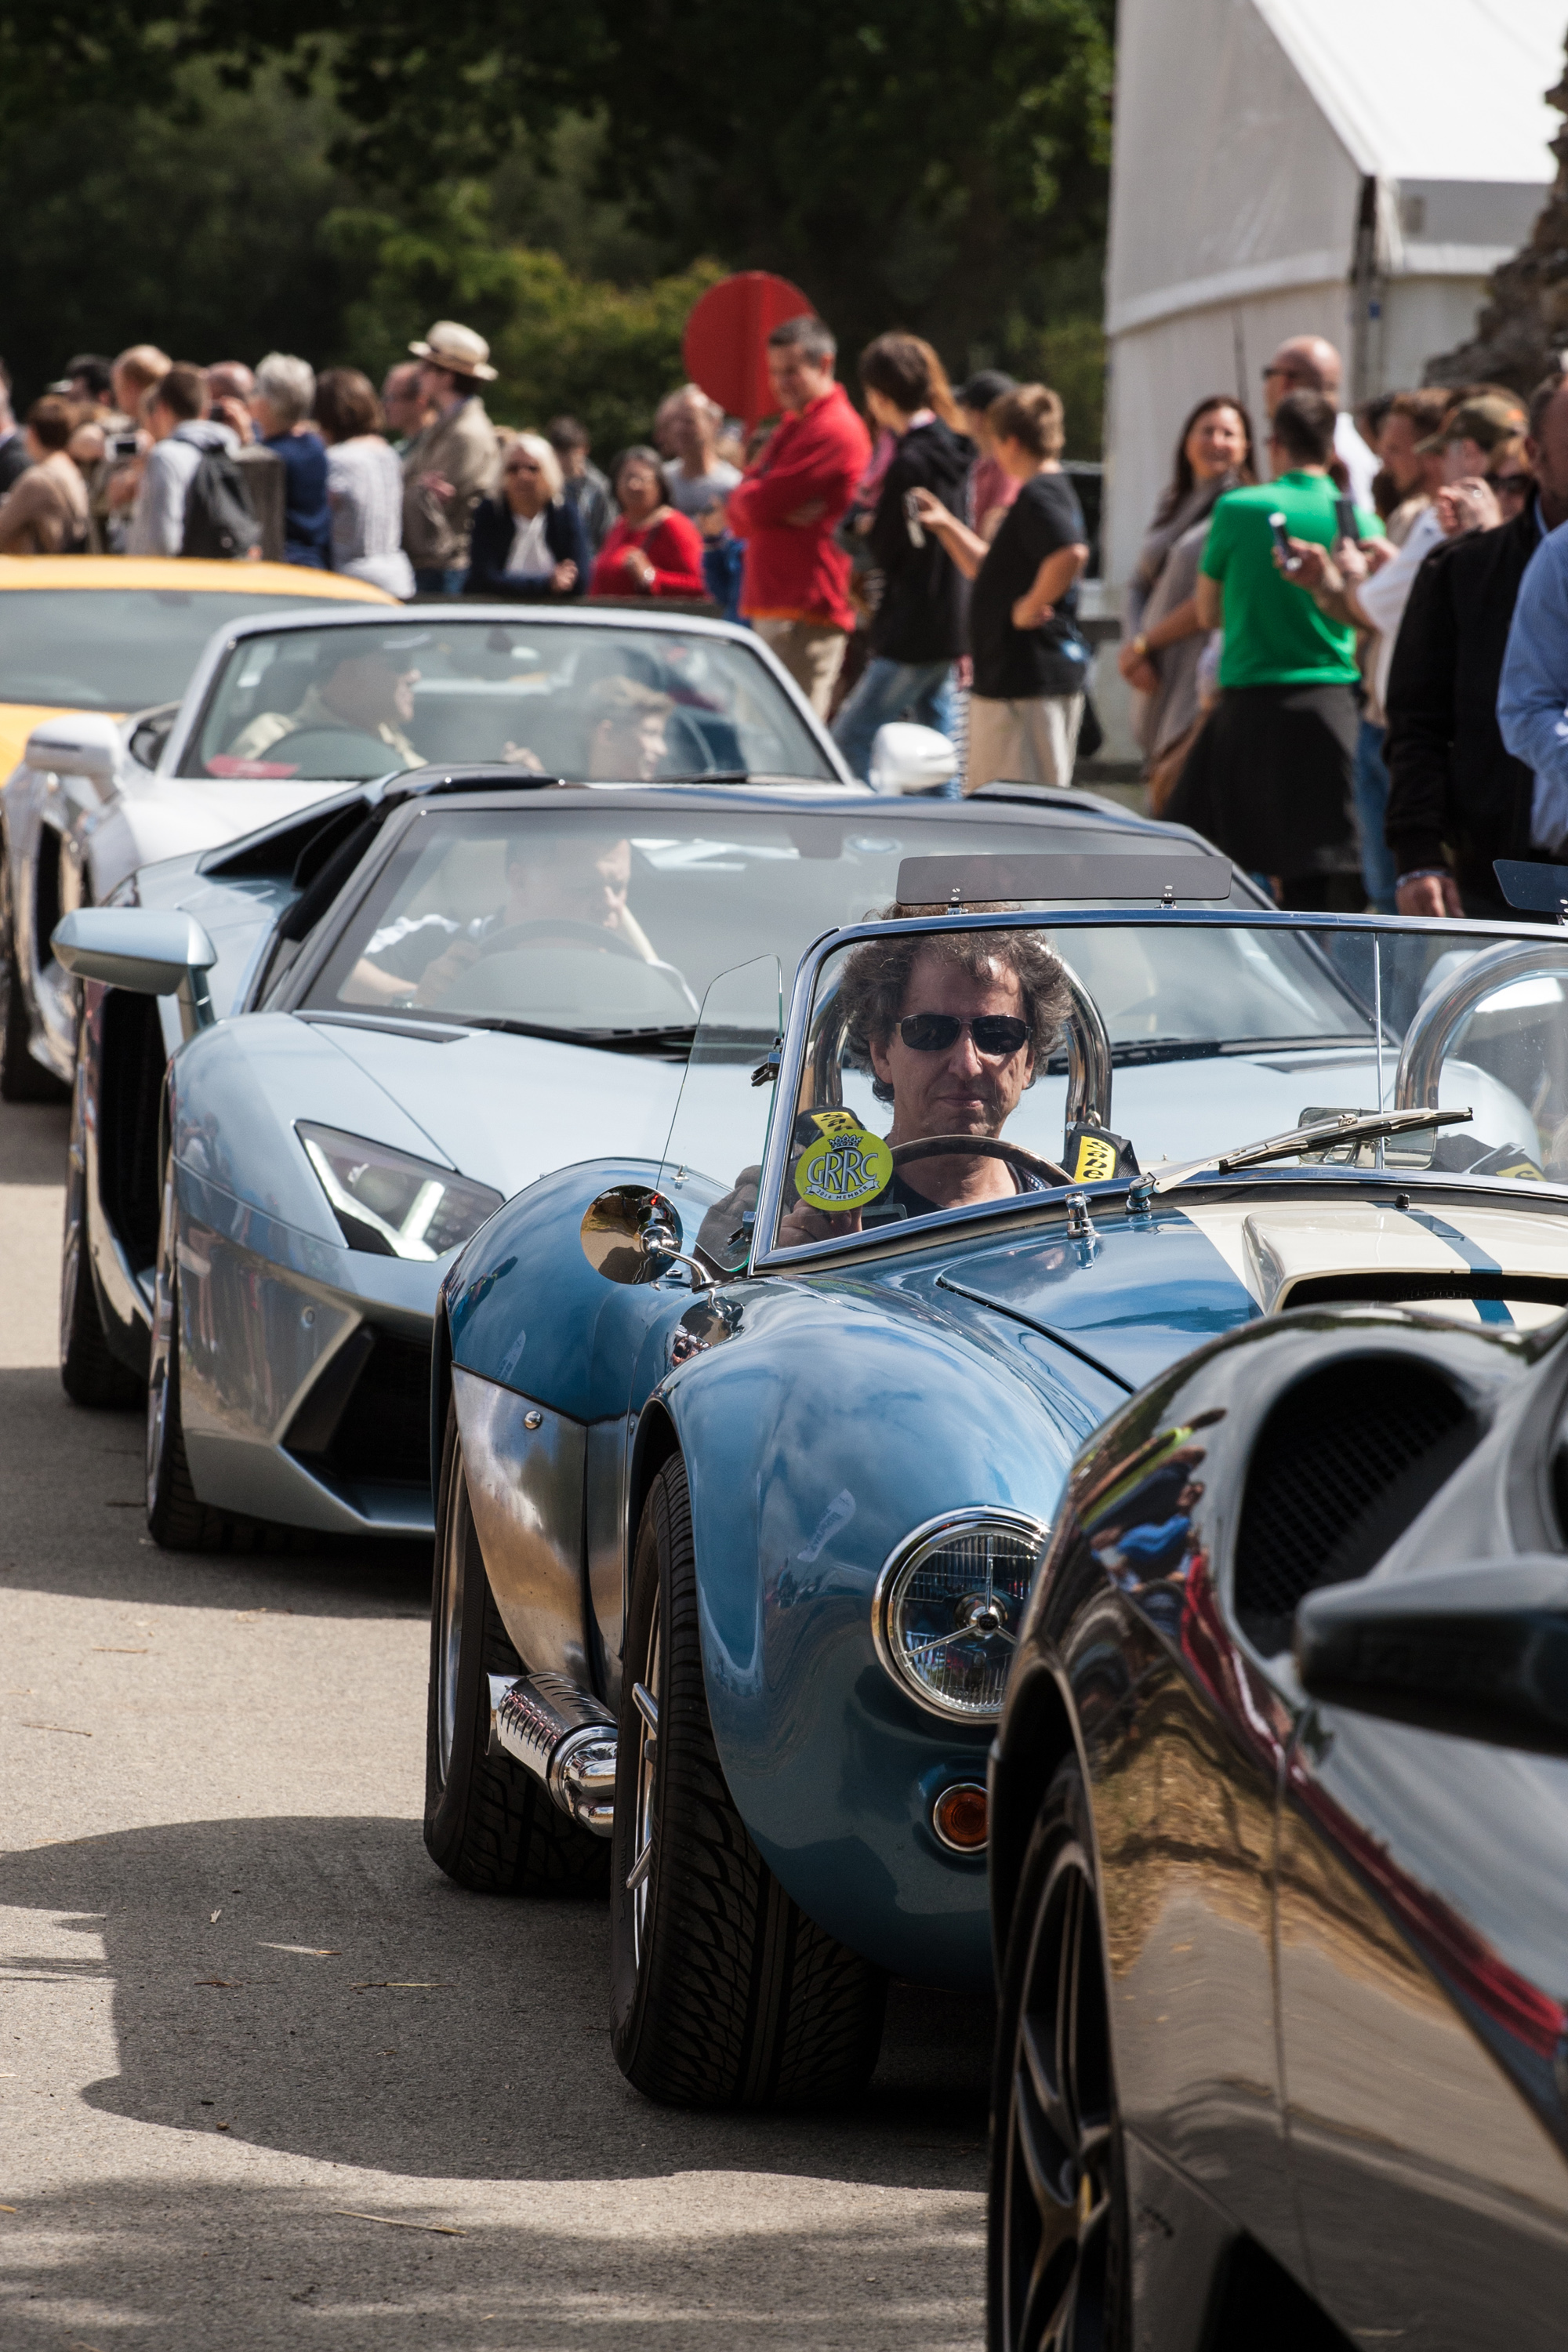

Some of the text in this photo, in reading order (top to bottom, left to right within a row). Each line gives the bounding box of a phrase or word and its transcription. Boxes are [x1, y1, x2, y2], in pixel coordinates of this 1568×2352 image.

[808, 1149, 879, 1193] GRRC
[816, 1185, 868, 1200] 2016 MEMBER
